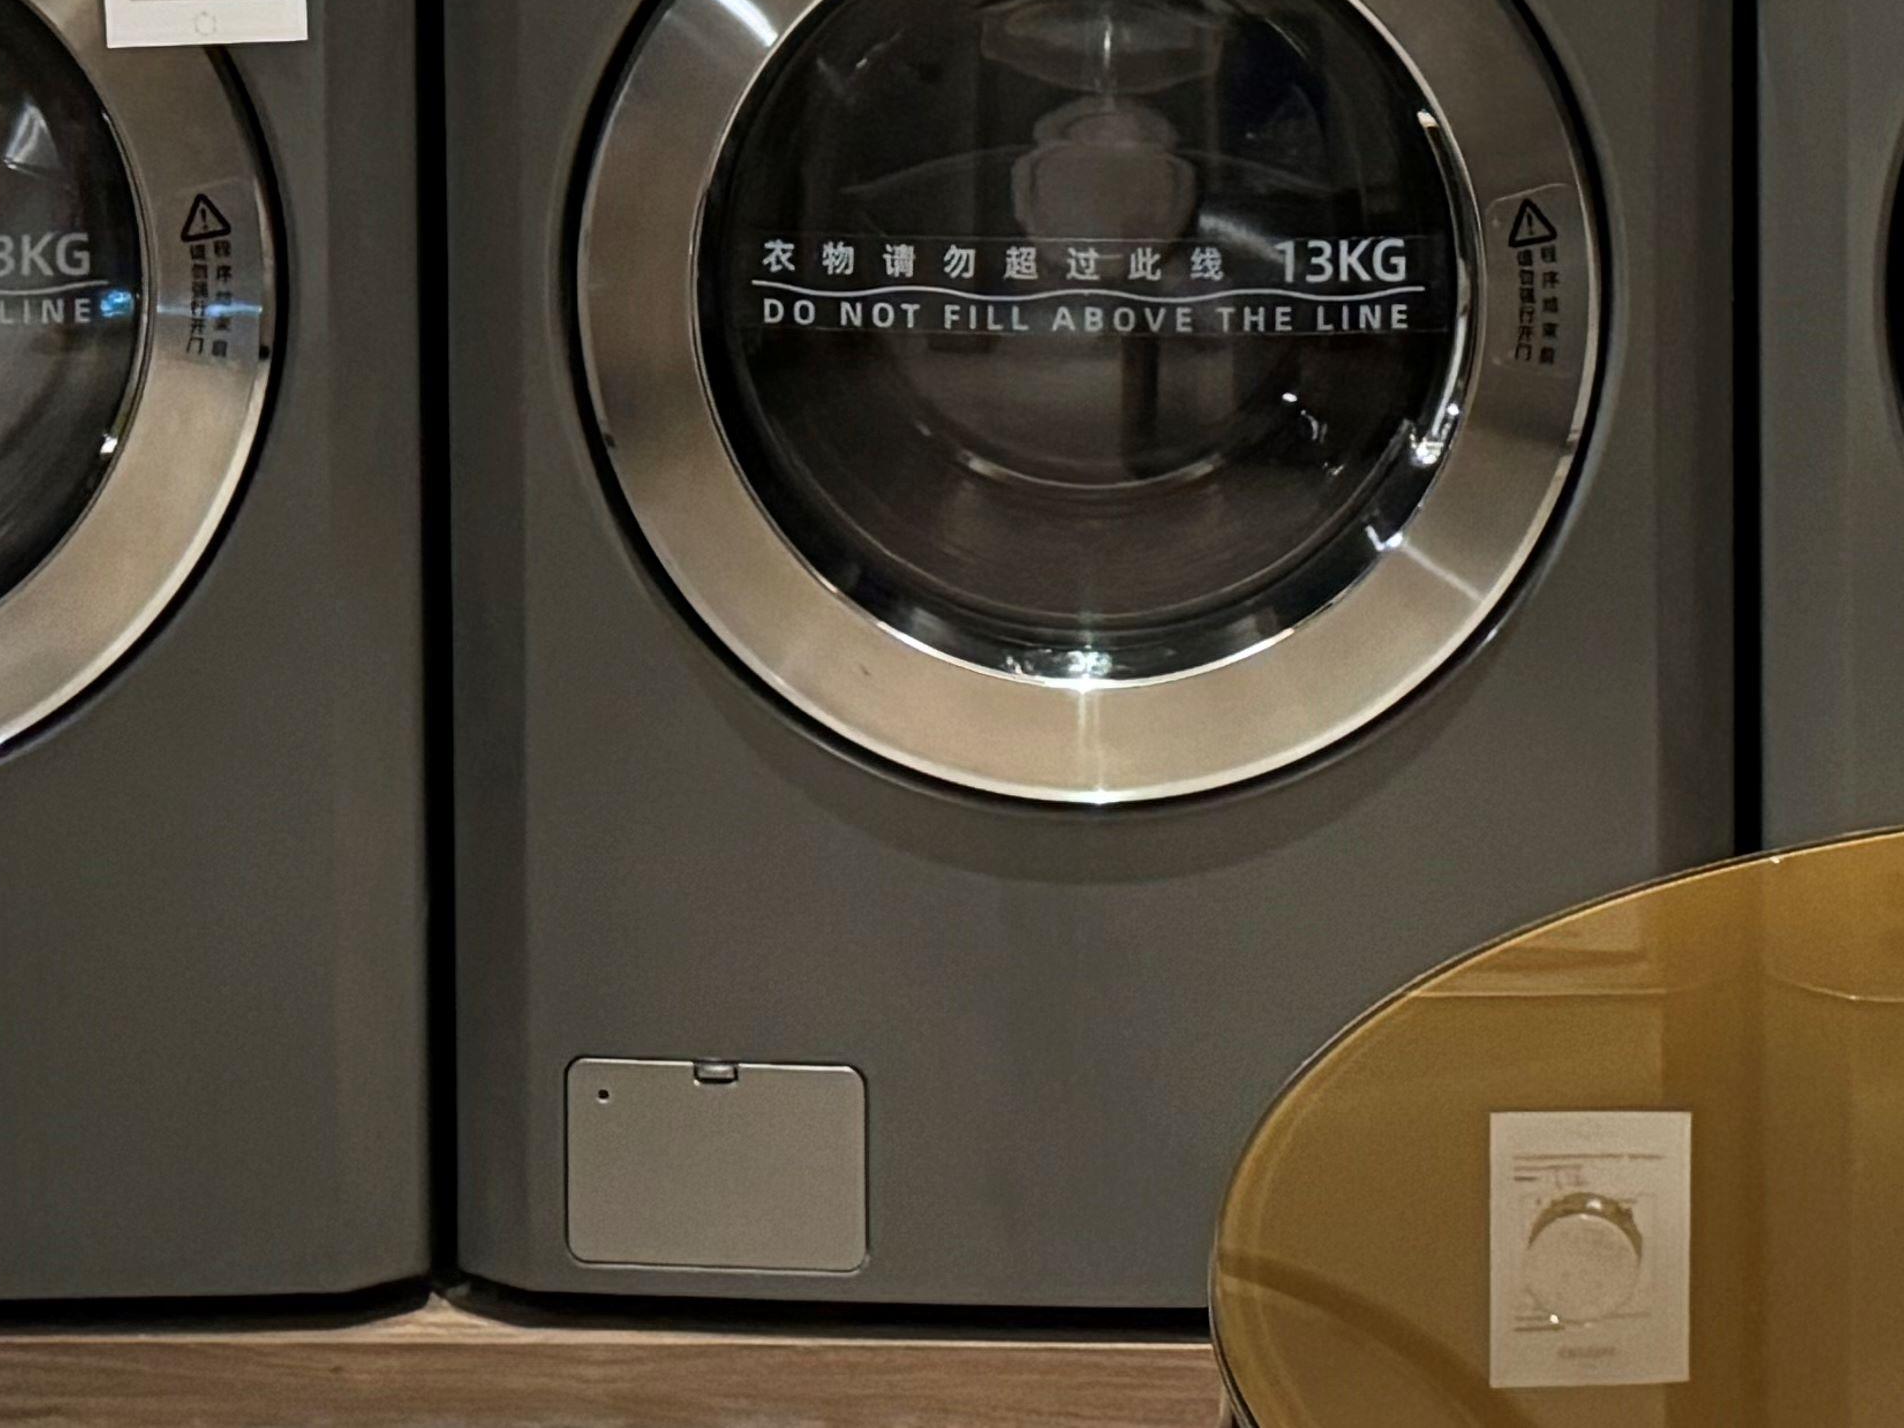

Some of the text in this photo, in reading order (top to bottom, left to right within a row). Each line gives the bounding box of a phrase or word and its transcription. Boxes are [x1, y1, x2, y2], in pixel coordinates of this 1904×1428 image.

[763, 239, 1406, 282] 衣物请勿超过此线 13KG
[0, 299, 90, 325] LINE
[764, 299, 1408, 332] DO NOT FILL ABOVE THE LINE
